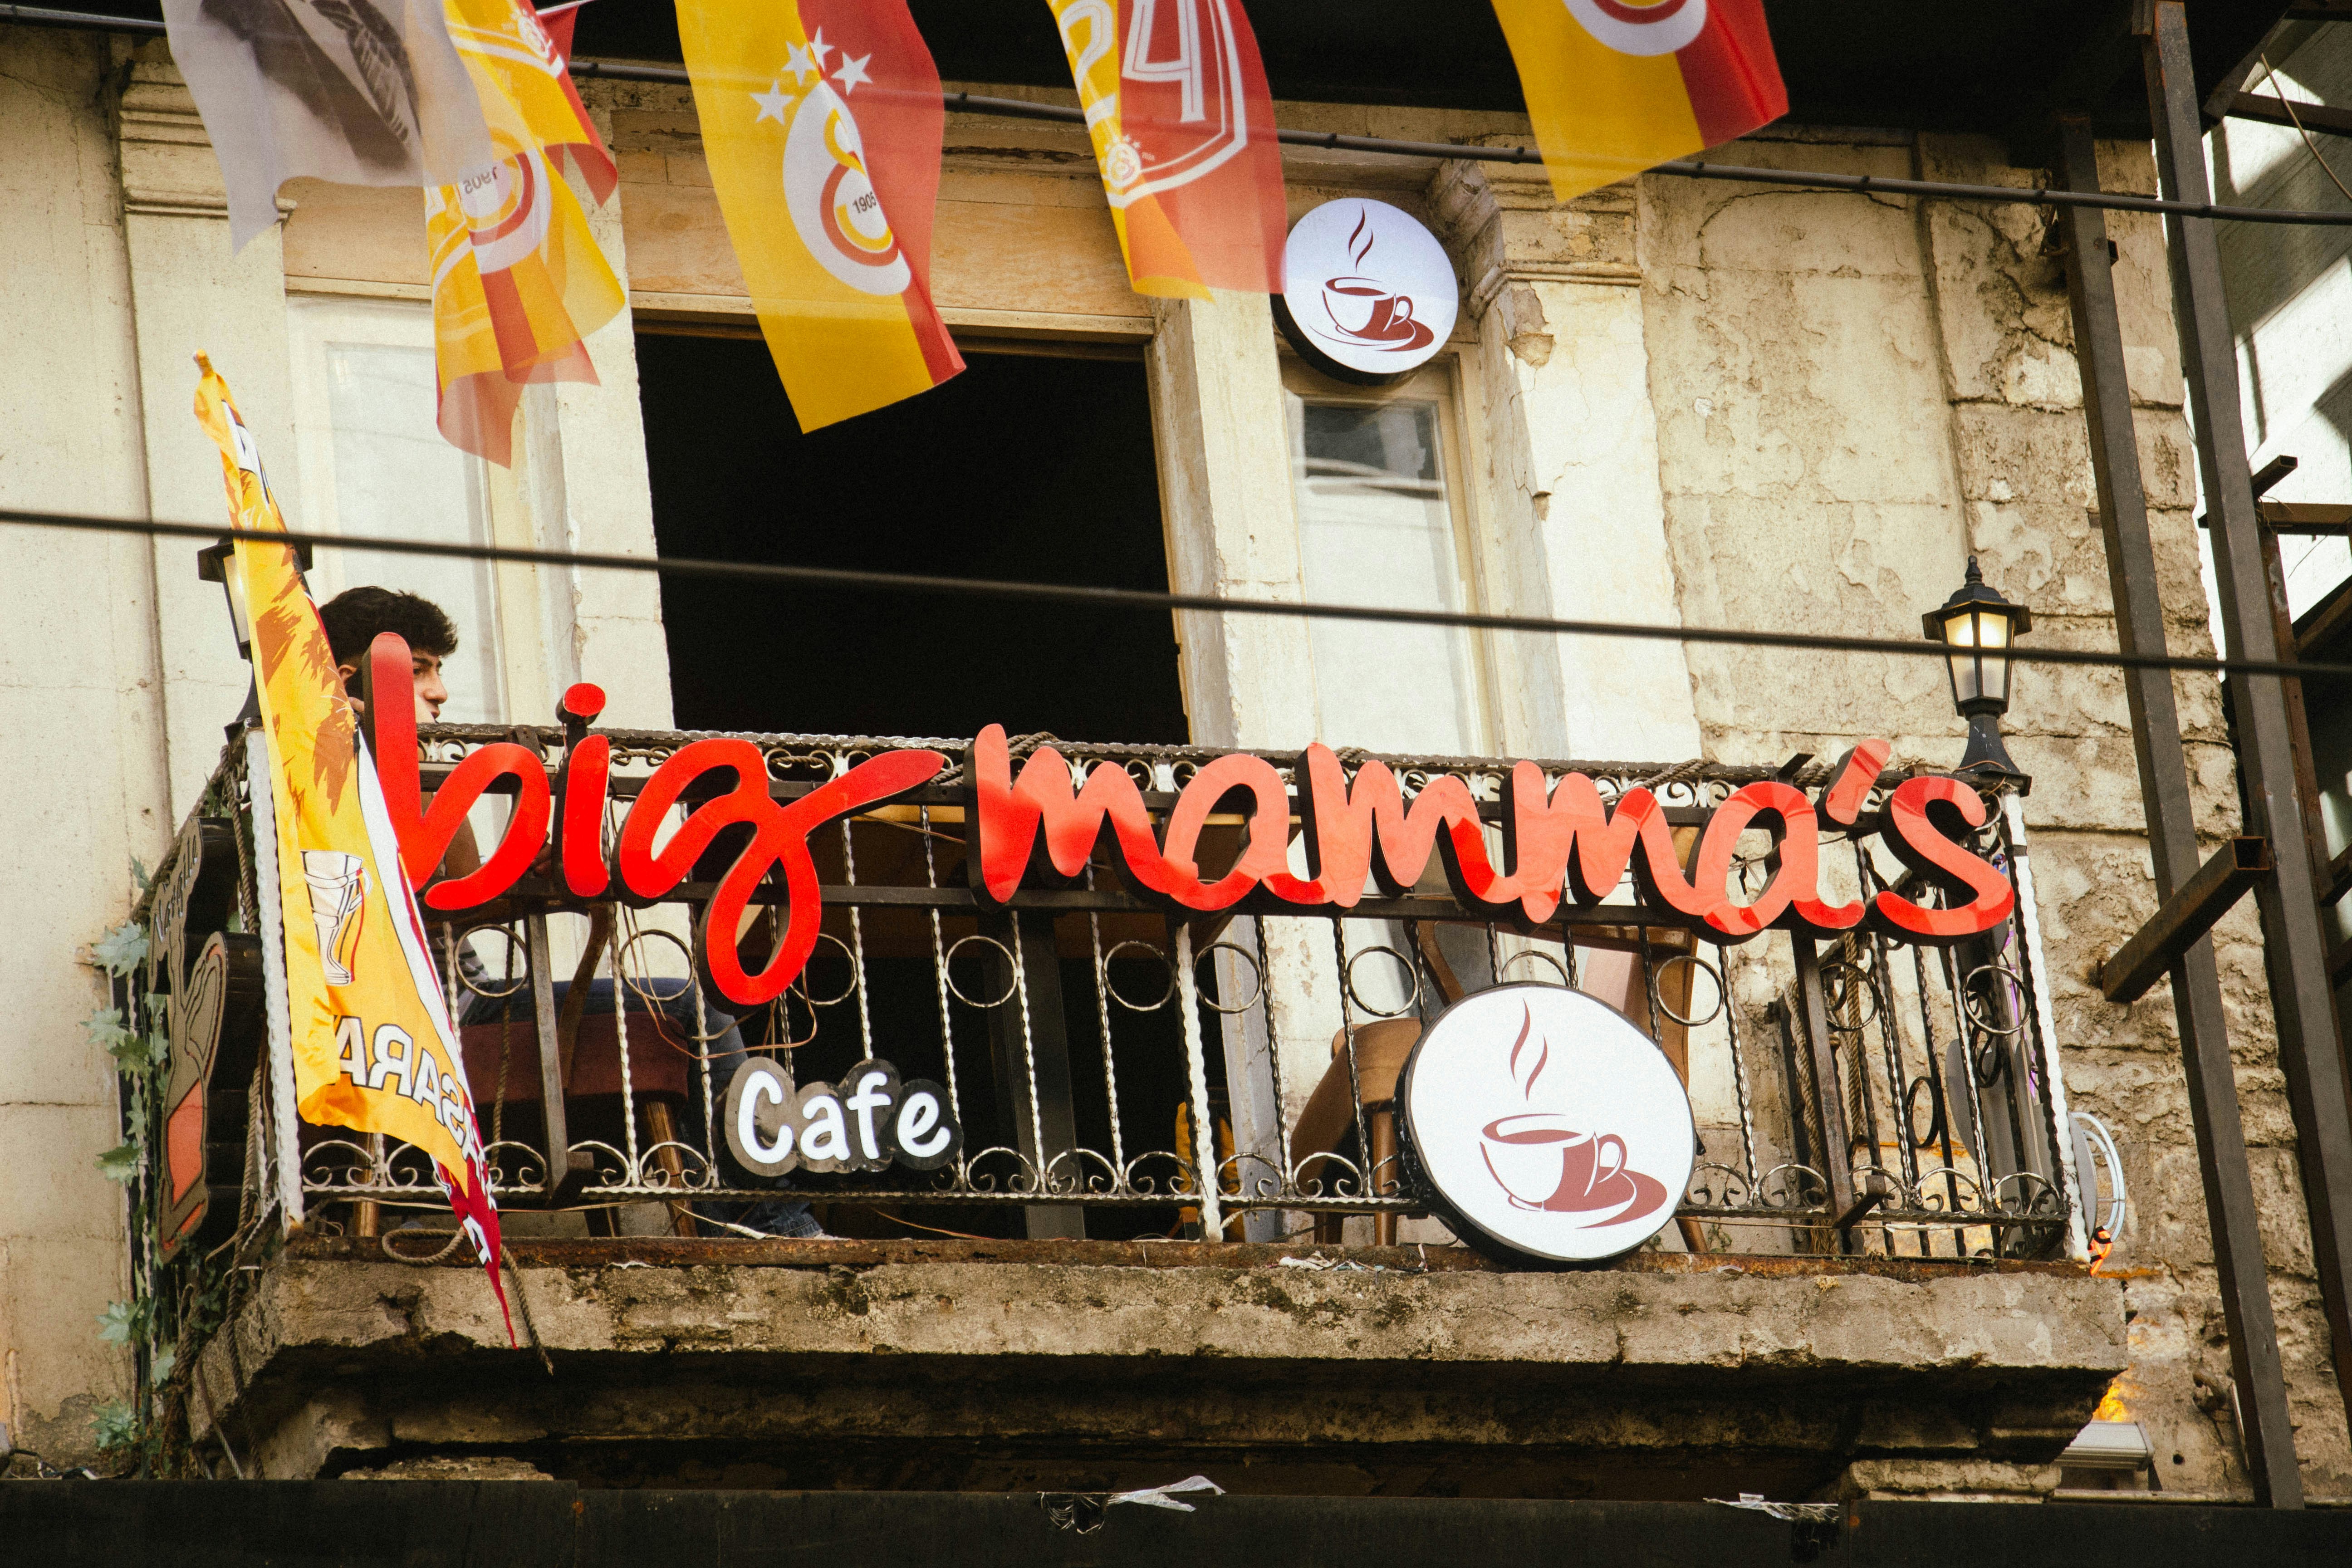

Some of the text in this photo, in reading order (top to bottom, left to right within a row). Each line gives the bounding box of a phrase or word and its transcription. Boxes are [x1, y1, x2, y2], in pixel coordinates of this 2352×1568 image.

[853, 191, 877, 214] 1905
[370, 632, 2015, 1005] big mamma's
[737, 1070, 951, 1164] Cafe
